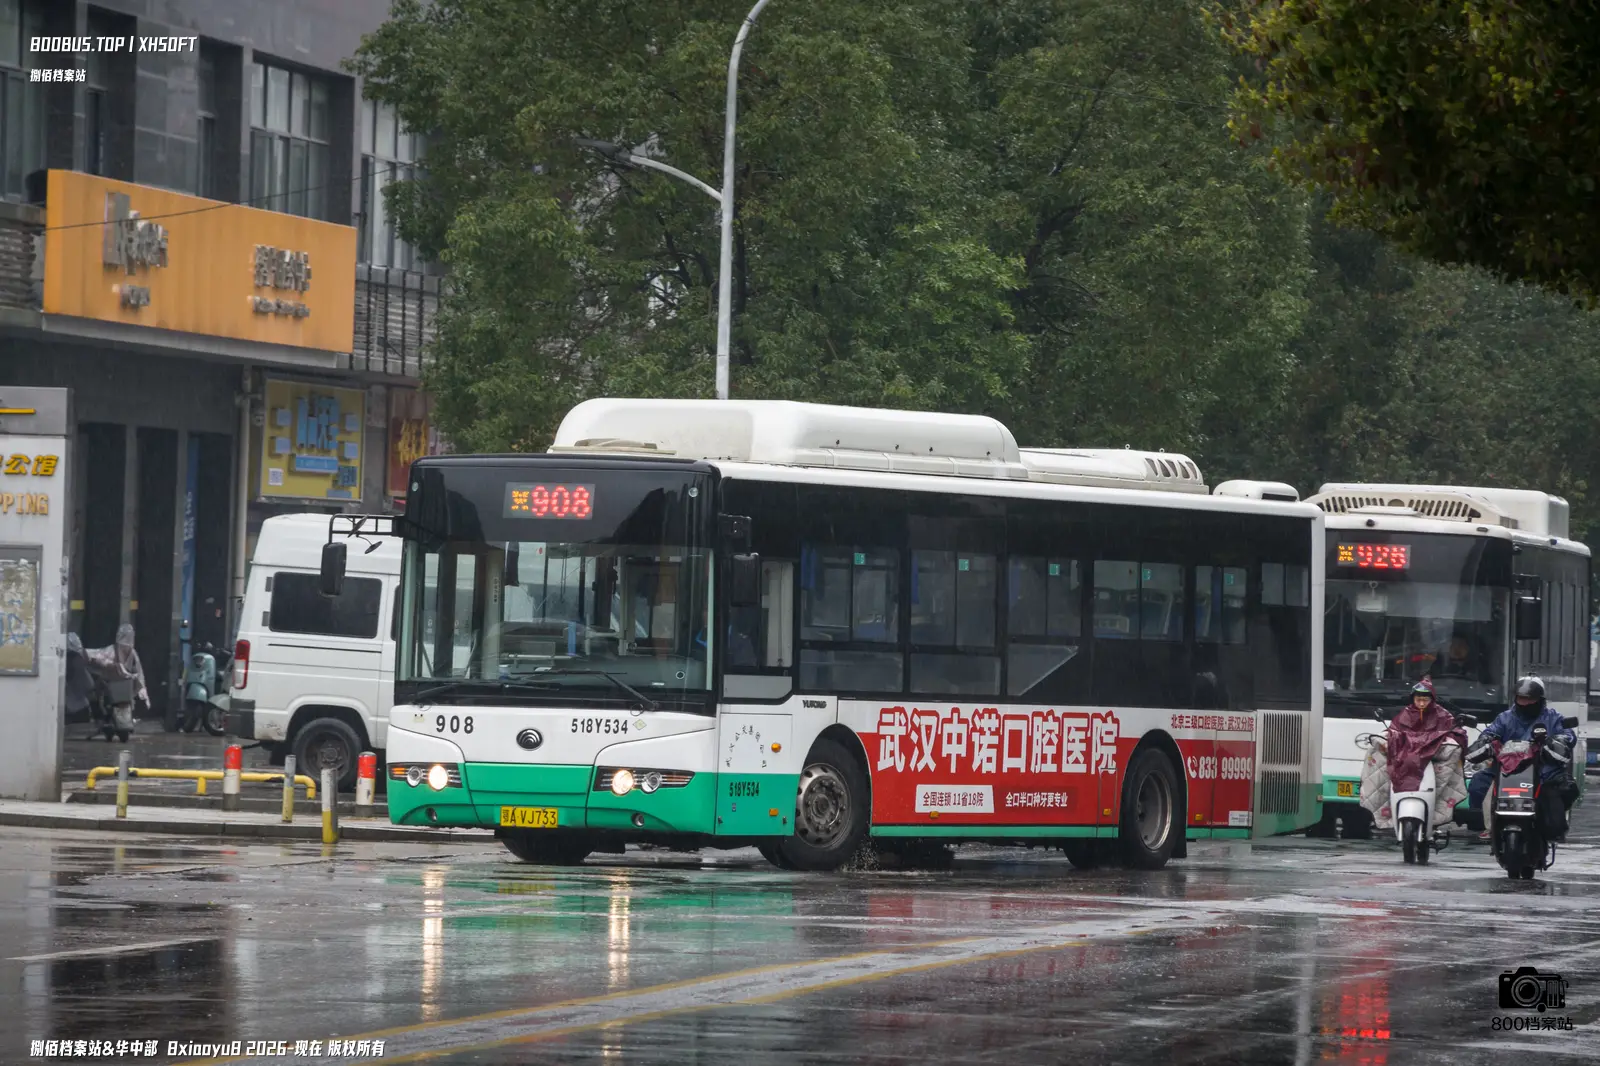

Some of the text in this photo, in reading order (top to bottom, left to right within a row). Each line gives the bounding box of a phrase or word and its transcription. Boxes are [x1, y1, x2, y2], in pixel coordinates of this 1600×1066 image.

[0, 454, 58, 476] 公馆
[532, 485, 591, 518] 908
[436, 715, 474, 734] 908
[571, 718, 628, 734] 518Y534
[877, 708, 1118, 775] 武汉中诺口腔医院
[1198, 756, 1253, 779] 833 99999
[729, 782, 760, 797] 518Y534
[1005, 792, 1068, 808] 全口半口种牙更专业
